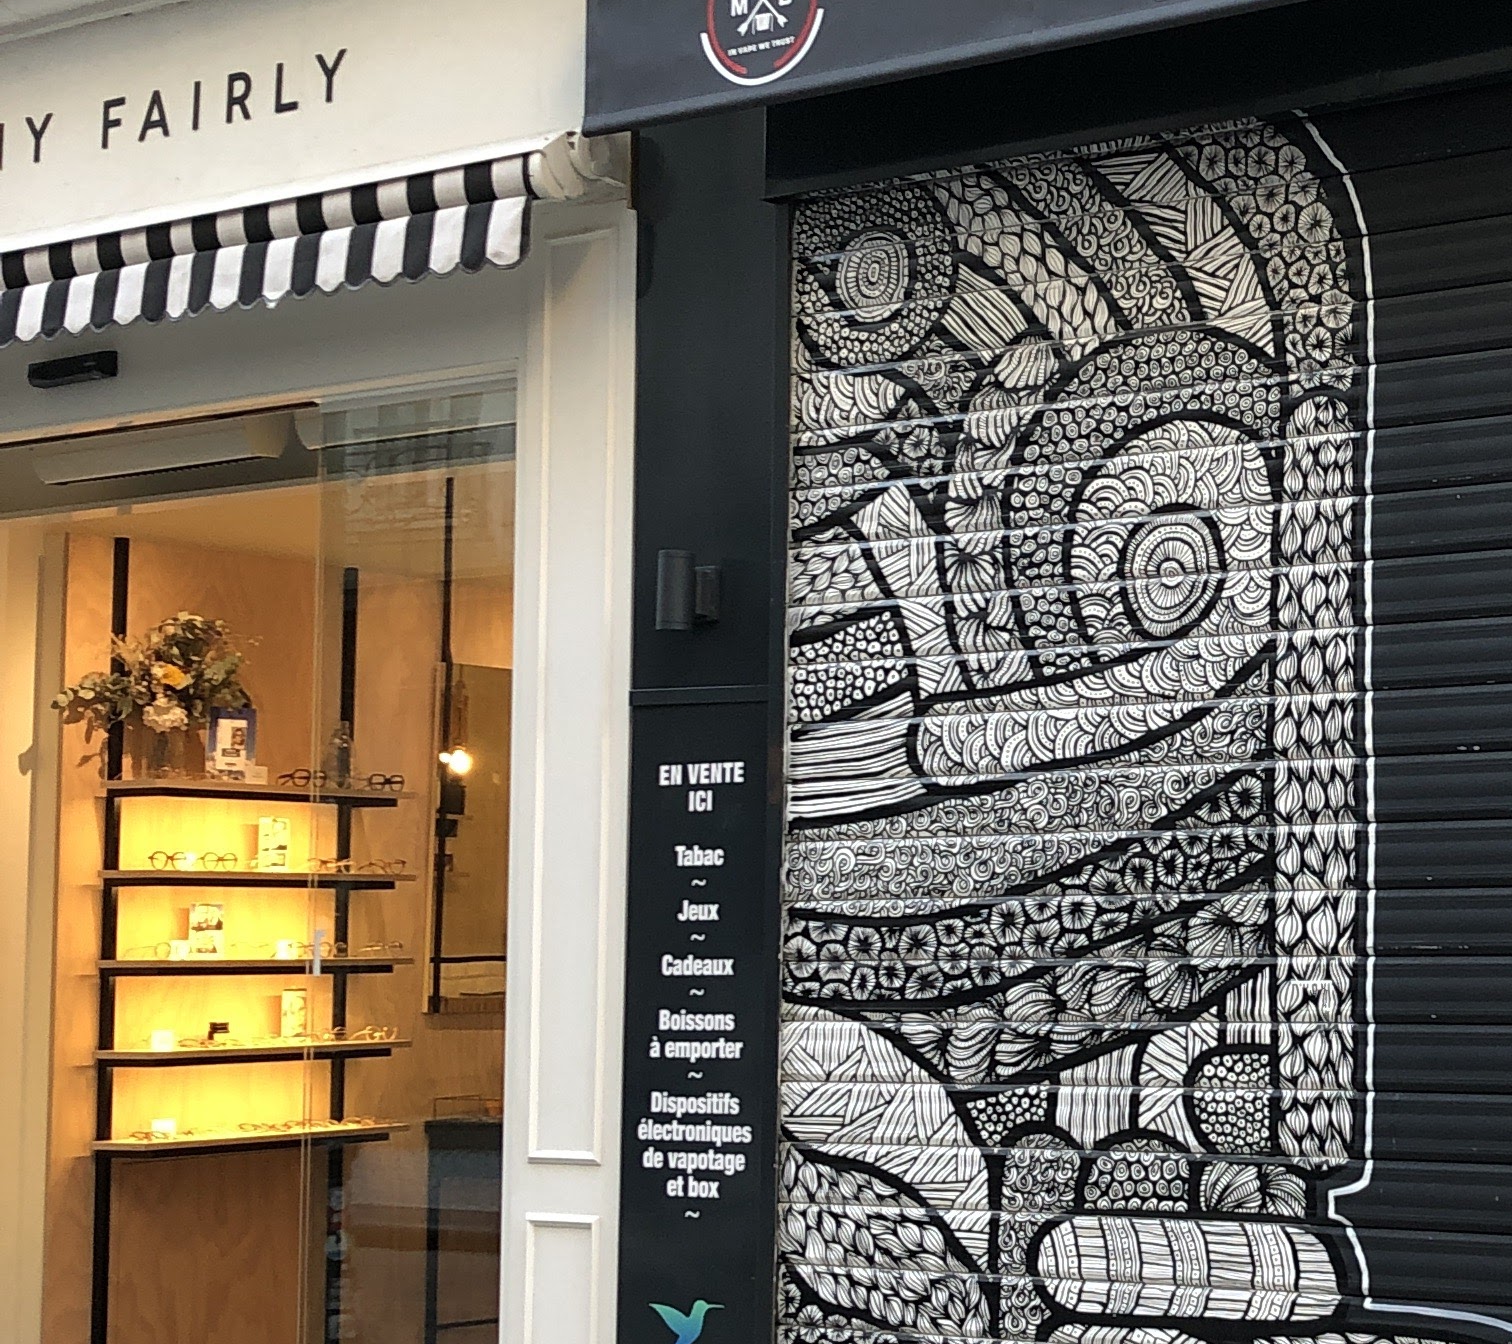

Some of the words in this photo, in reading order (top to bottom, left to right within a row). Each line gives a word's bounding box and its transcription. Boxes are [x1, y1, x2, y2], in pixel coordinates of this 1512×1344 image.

[0, 112, 54, 171] Y
[101, 48, 348, 150] FAIRLY
[658, 764, 683, 786] EN
[687, 761, 745, 785] VENTE
[687, 790, 713, 812] ICI
[674, 844, 725, 867] Tabac
[677, 899, 720, 922] Jeux
[661, 954, 735, 977] Cadeaux
[658, 1008, 736, 1031] Boissons
[649, 1035, 661, 1058] à
[664, 1037, 744, 1063] emporter
[650, 1091, 740, 1118] Dispositifs
[637, 1117, 753, 1148] électroniques
[642, 1147, 664, 1169] de
[667, 1149, 746, 1176] vapotage
[666, 1175, 684, 1197] et
[687, 1175, 720, 1199] box
